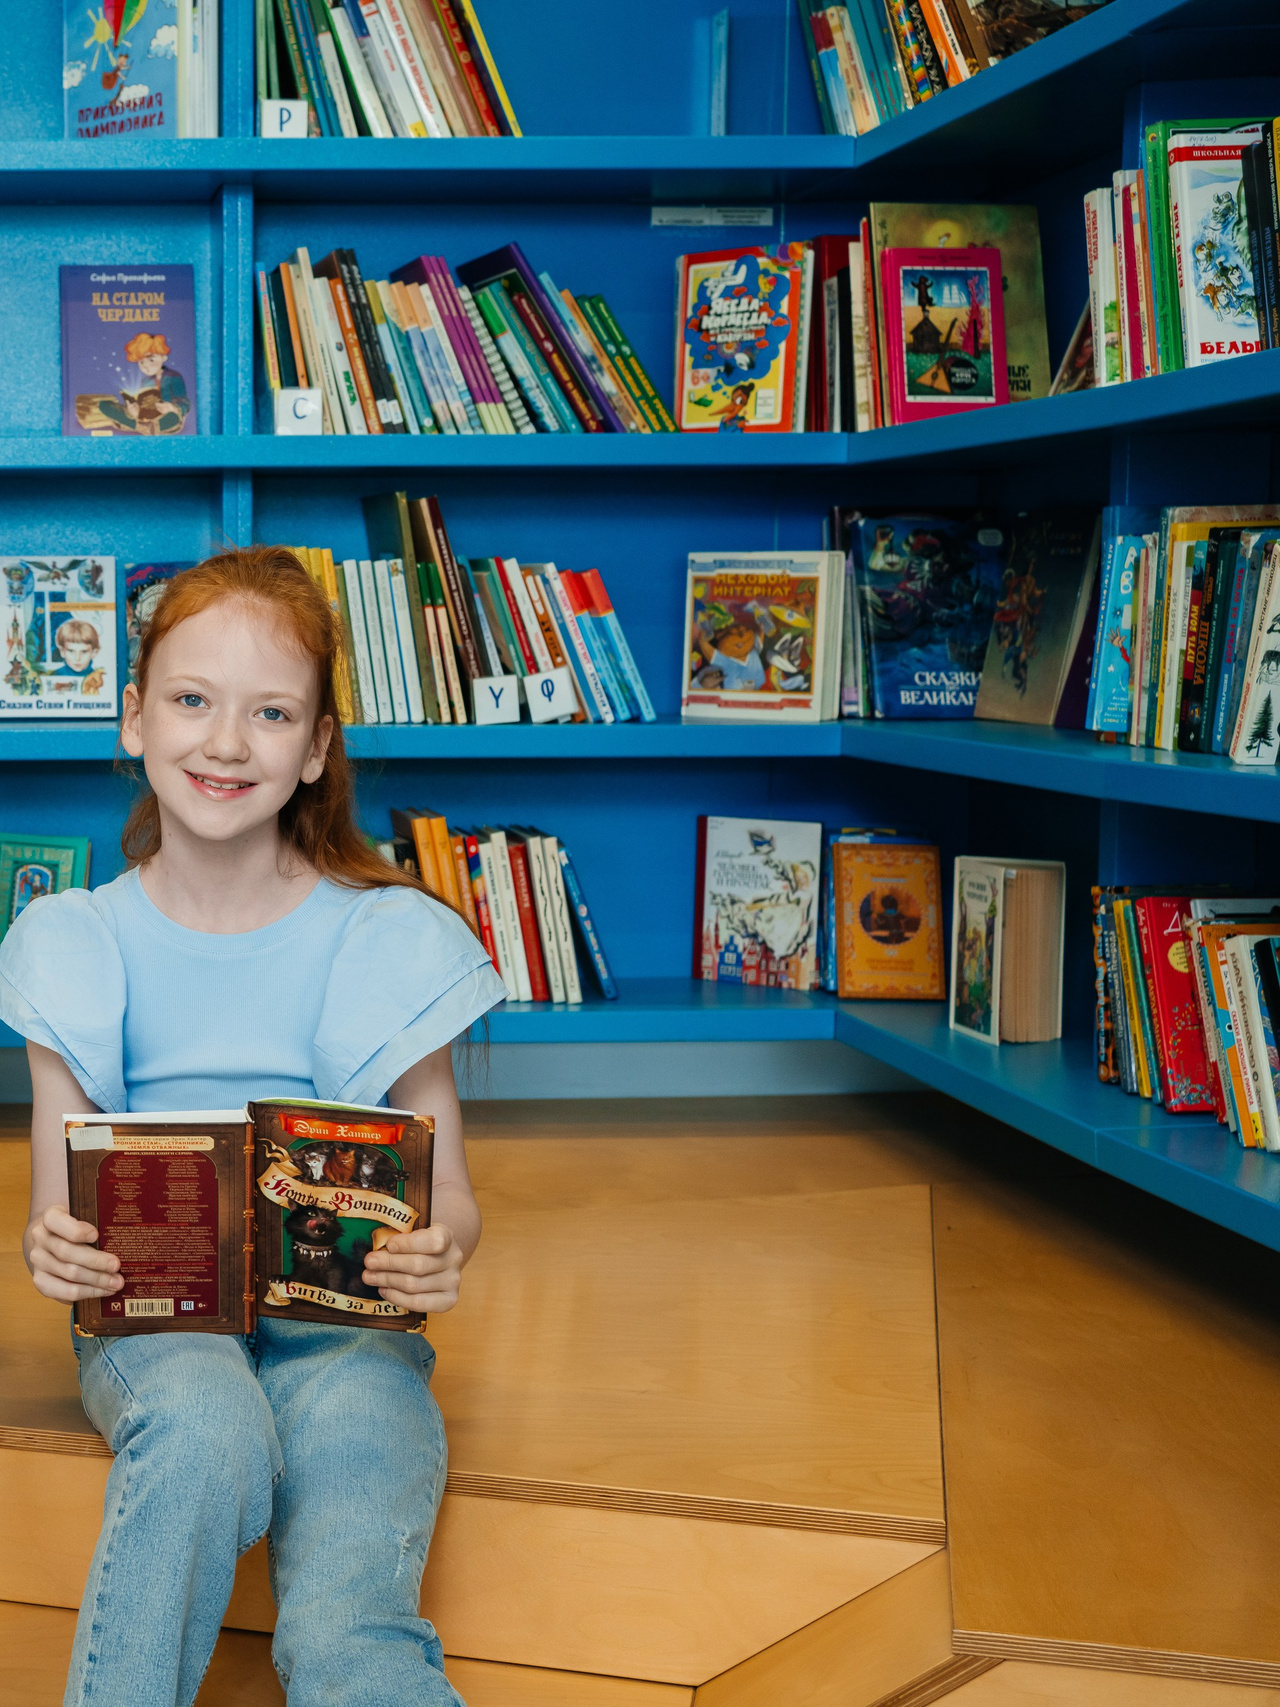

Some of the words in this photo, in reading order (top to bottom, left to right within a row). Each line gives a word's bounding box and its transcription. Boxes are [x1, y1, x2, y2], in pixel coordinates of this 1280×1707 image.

[280, 107, 292, 132] Р
[1192, 149, 1242, 158] ШКОЛЬНАЯ
[92, 292, 110, 305] НА
[113, 292, 165, 305] СТАРОМ
[97, 308, 160, 322] ЧЕРДАКЕ
[715, 572, 790, 585] МЕХОВОЙ
[1233, 567, 1244, 602] ОГОНЬ
[714, 586, 790, 597] ИНТЕРНАТ
[1231, 606, 1239, 618] ЗА
[1186, 635, 1197, 662] ПУТЬ
[1192, 620, 1210, 685] ШКОЛА
[1224, 623, 1237, 663] БОРЬБА
[489, 686, 504, 709] У
[541, 679, 555, 702] Ф
[1228, 719, 1243, 756] РАССКАЗЫ
[1238, 681, 1252, 712] ПРИРОДЕ
[1230, 1010, 1241, 1036] СКАЗКИ
[1235, 1037, 1249, 1075] ДЯДЮШКИ
[1243, 1077, 1255, 1105] РИМУСА
[294, 1120, 329, 1136] Эрин
[335, 1125, 382, 1140] Хантер
[285, 1283, 336, 1305] Битва
[346, 1298, 363, 1310] за
